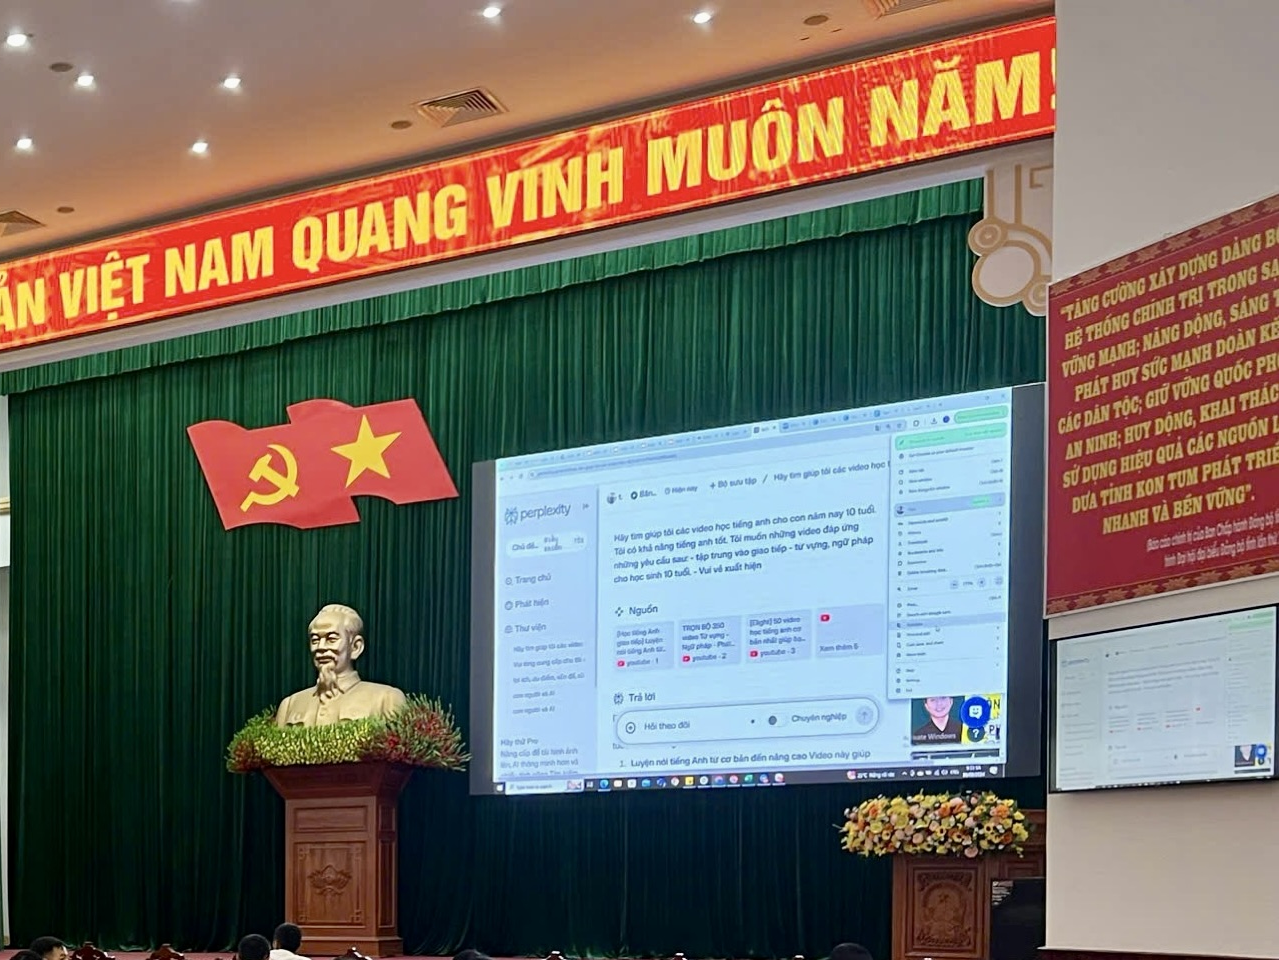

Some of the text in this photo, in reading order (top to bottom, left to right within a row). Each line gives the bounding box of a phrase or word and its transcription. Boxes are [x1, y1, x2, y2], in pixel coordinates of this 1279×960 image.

[58, 251, 150, 320] VIỆT
[165, 225, 275, 299] NAM
[291, 183, 467, 273] QUANG
[646, 94, 845, 196] MUÔN
[1132, 298, 1176, 326] CHÍNH
[1206, 265, 1257, 299] TRONG
[1229, 295, 1269, 322] SÁNG
[1057, 409, 1081, 435] CÁC
[1256, 352, 1279, 376] PH
[1075, 374, 1110, 402] PHÁT
[1112, 366, 1139, 391] HUY
[1065, 438, 1083, 460] AN
[1086, 430, 1121, 455] NINH;
[1124, 420, 1151, 444] HUY
[1199, 396, 1236, 423] KHAI
[1239, 382, 1279, 412] THÁC
[1187, 431, 1214, 456] CÁC
[1136, 475, 1165, 498] KON
[1168, 468, 1198, 491] TUM
[1202, 454, 1242, 482] PHÁT
[520, 504, 571, 522] perplexity
[692, 524, 713, 533] video
[755, 518, 770, 527] anh
[772, 515, 788, 525] cho
[790, 514, 806, 522] con
[828, 510, 844, 520] nay
[846, 507, 856, 516] 10
[1102, 507, 1149, 535] NHANH
[1152, 499, 1170, 524] VÀ
[698, 538, 713, 547] anh
[798, 527, 821, 536] video
[711, 550, 733, 560] trung
[751, 547, 769, 557] giao
[515, 575, 536, 585] Trang
[659, 721, 676, 729] theo
